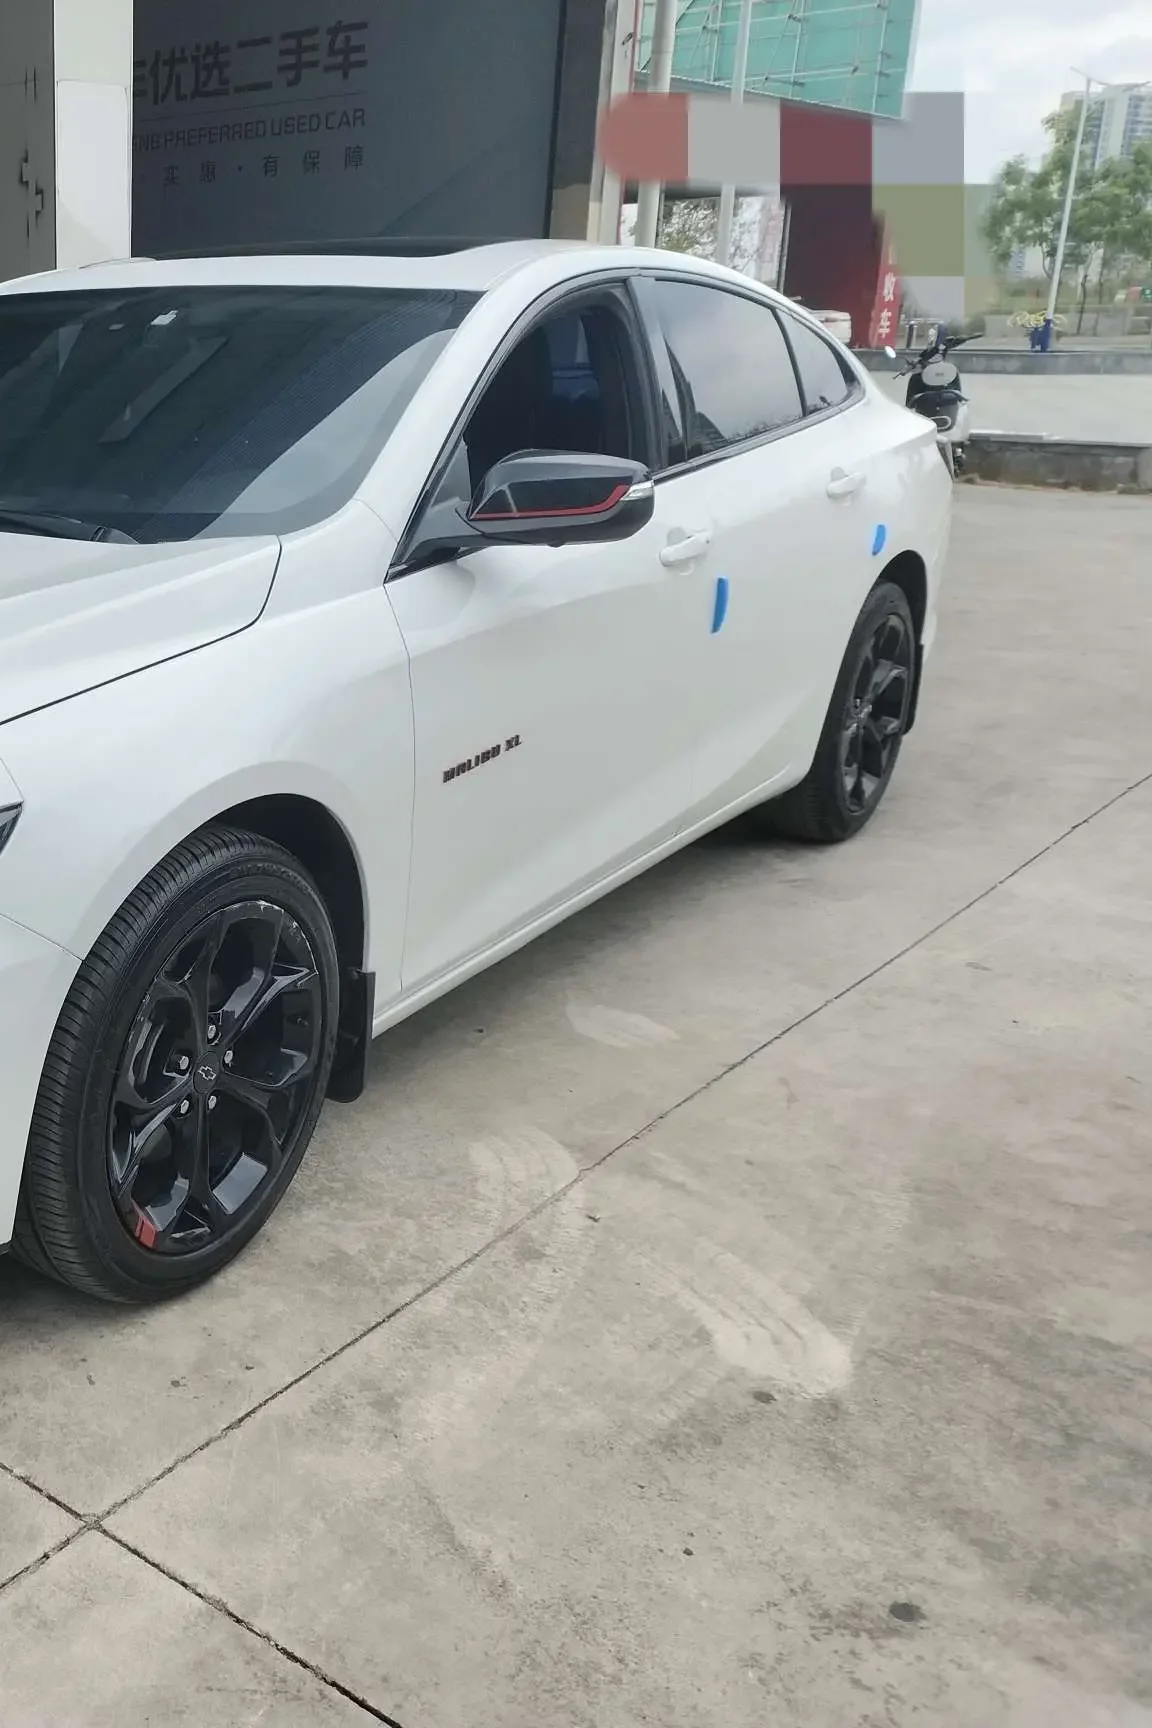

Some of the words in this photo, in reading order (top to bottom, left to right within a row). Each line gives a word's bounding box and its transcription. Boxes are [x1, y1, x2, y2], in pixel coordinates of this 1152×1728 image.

[164, 120, 267, 148] PREFERRED
[271, 113, 321, 137] USED
[325, 108, 366, 130] CAR
[443, 744, 501, 783] MALIBU
[505, 734, 522, 751] XL
